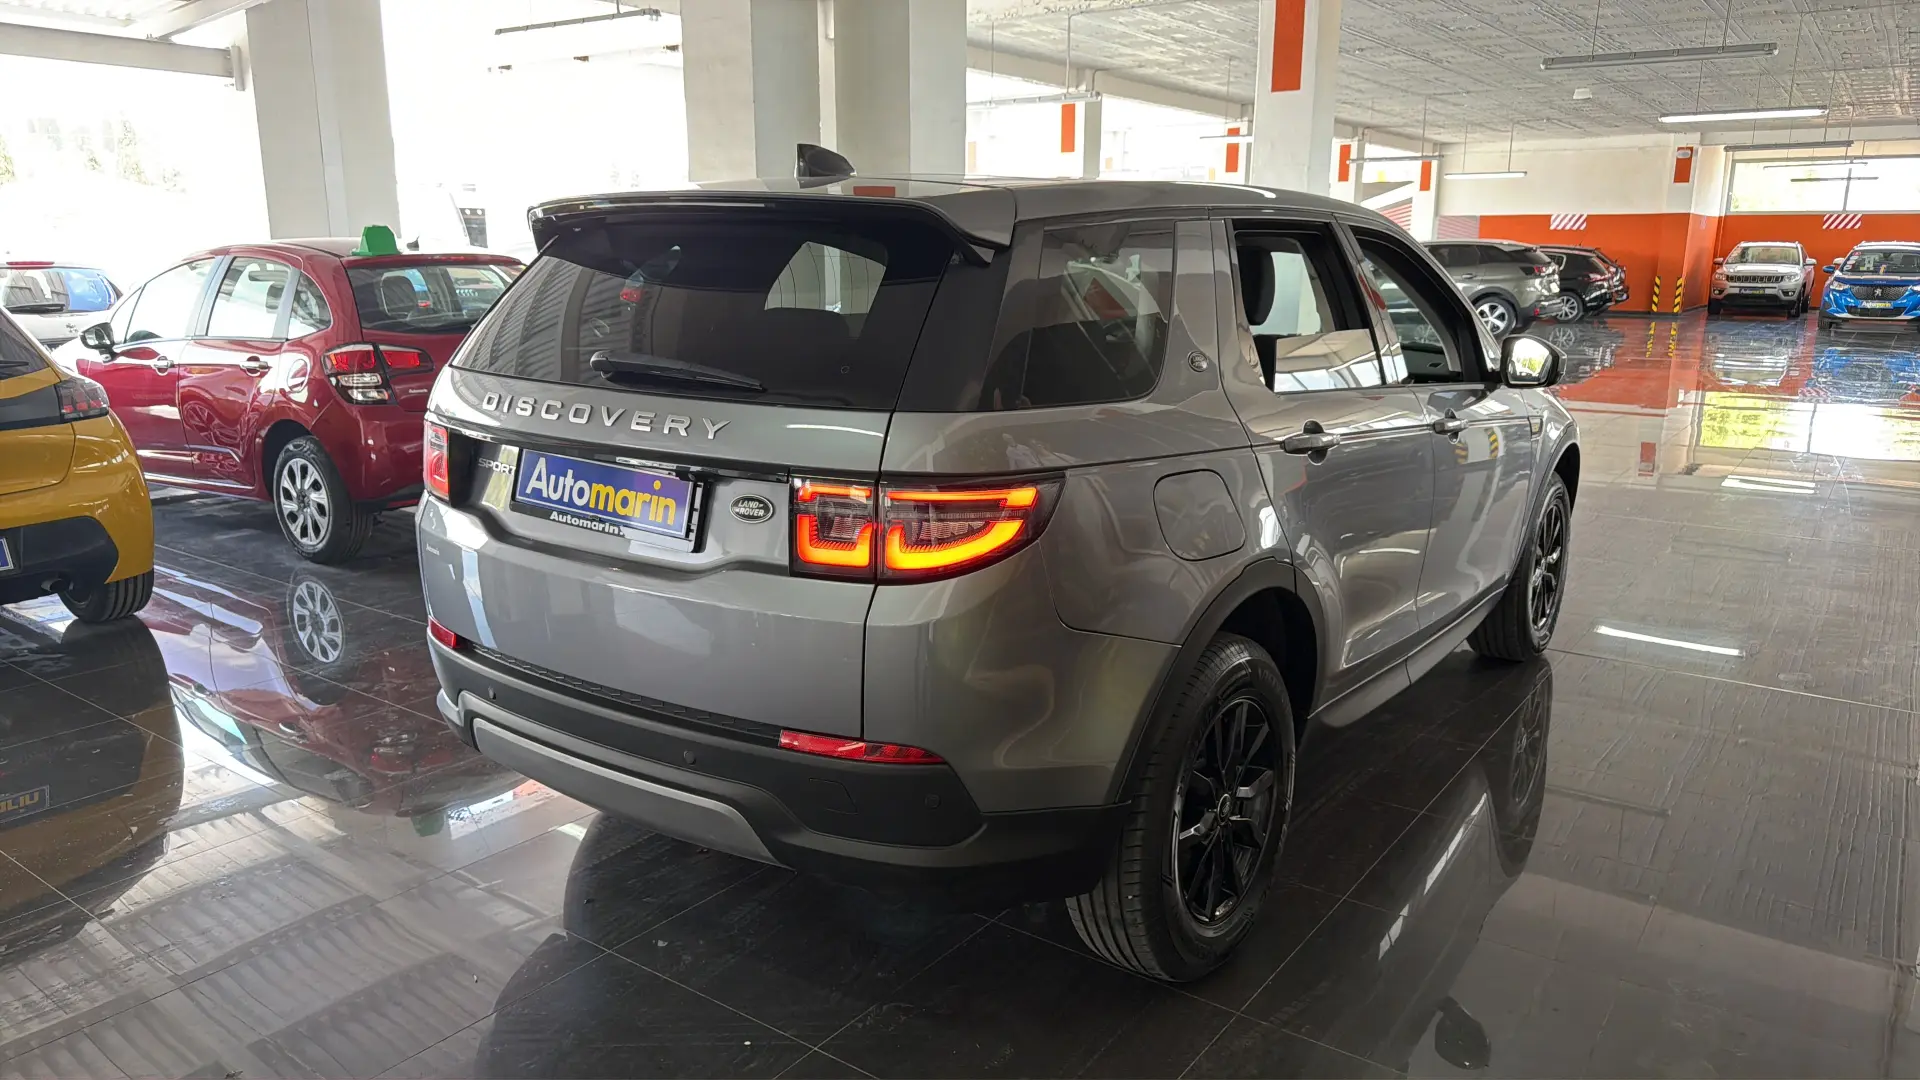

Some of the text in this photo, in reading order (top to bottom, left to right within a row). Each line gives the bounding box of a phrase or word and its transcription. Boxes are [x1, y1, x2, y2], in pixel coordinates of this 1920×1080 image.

[482, 392, 731, 440] DISCOVERY
[478, 457, 516, 475] SPORT
[525, 457, 677, 526] Automarin
[738, 499, 759, 509] LAND
[738, 507, 765, 516] ROVER
